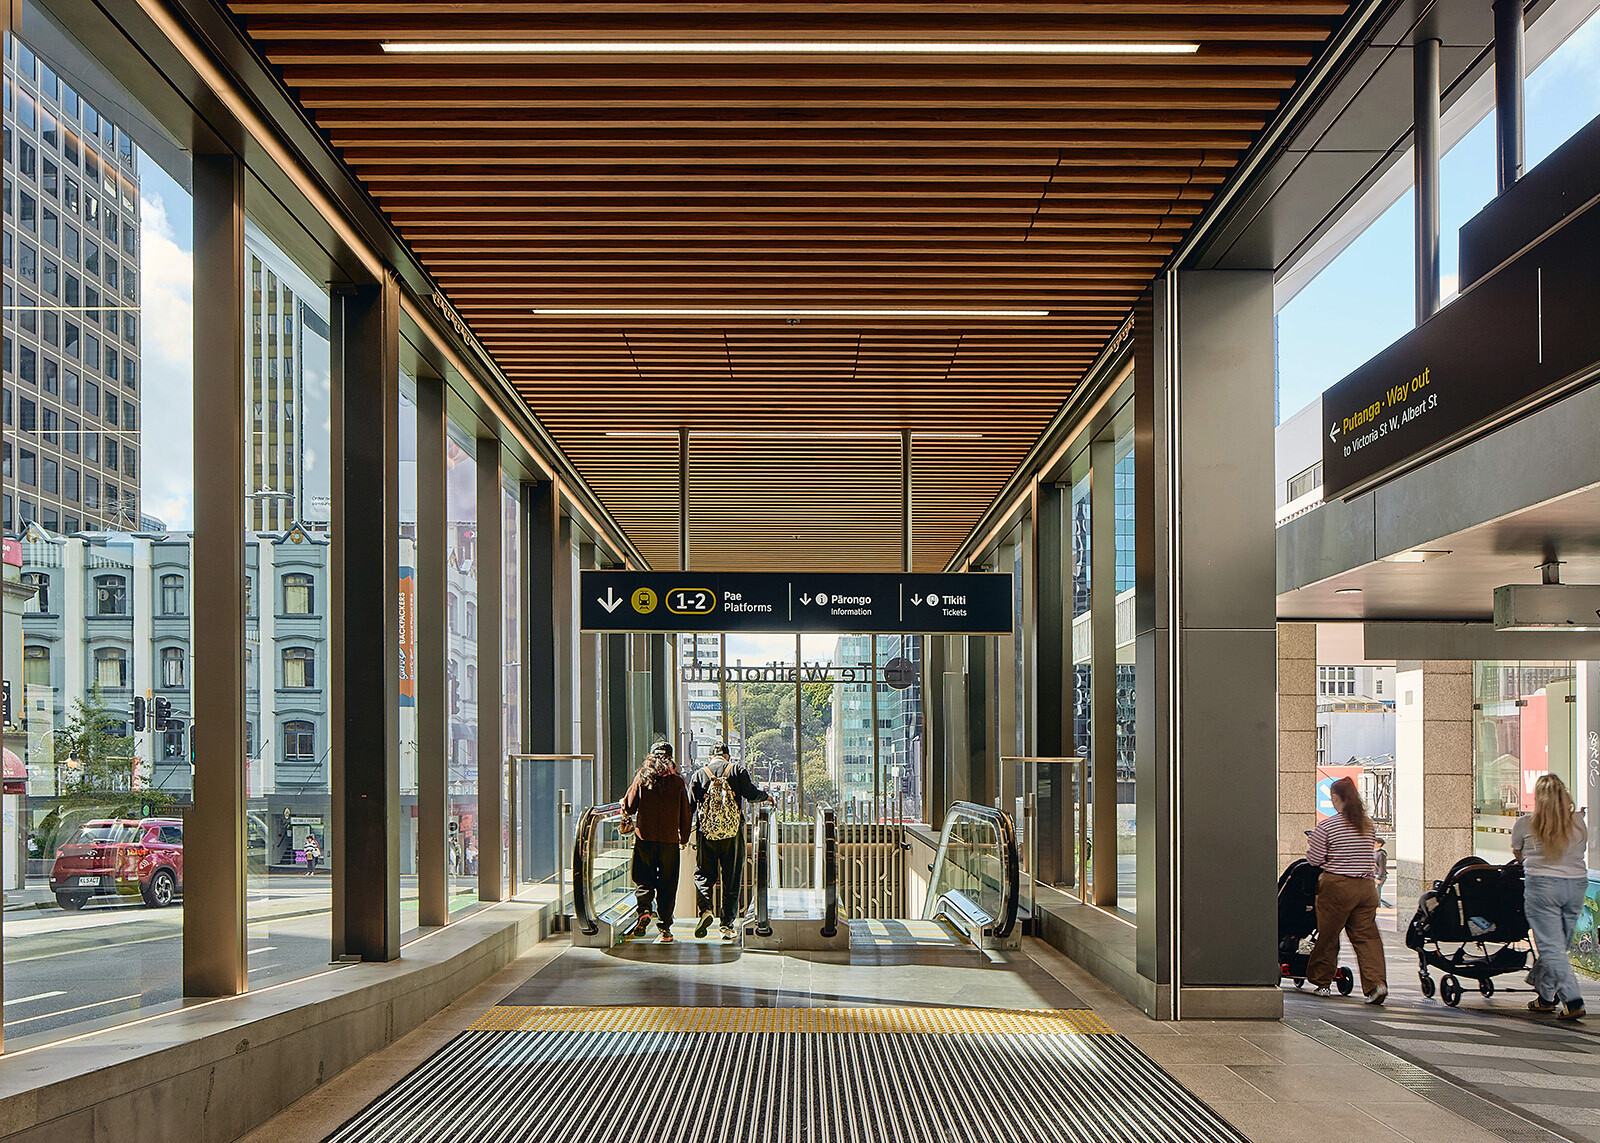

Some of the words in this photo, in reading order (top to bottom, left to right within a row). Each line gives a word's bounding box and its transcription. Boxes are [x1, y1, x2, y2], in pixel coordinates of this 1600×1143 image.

[1342, 401, 1381, 435] Putanga
[1386, 382, 1410, 407] Way
[1411, 366, 1431, 392] out
[1343, 445, 1352, 458] to
[1351, 428, 1379, 452] Victoria
[1379, 422, 1388, 437] St
[1389, 415, 1400, 431] W,
[1401, 399, 1427, 425] Albert
[1428, 393, 1438, 410] St
[676, 592, 707, 610] 1-2
[724, 591, 742, 601] Pae
[831, 594, 872, 605] Pārongo
[724, 602, 773, 613] Platforms
[831, 607, 872, 616] Information
[942, 608, 968, 617] Tickets
[398, 592, 406, 645] BACKPACKERS
